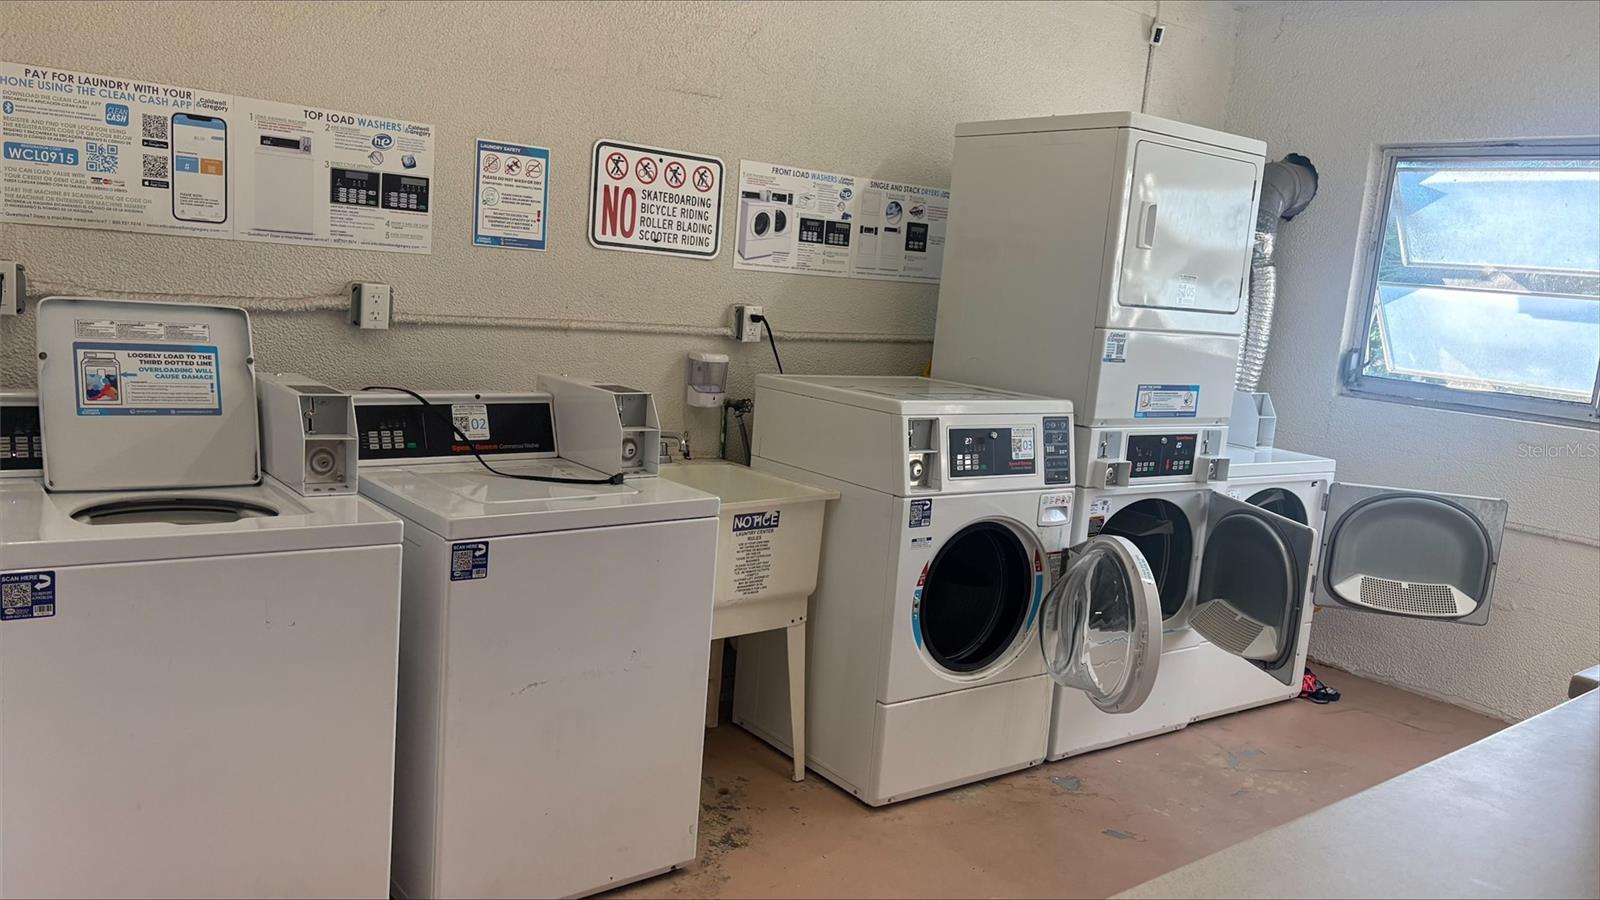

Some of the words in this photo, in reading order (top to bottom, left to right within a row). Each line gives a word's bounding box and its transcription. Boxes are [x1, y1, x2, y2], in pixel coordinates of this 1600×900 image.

[25, 68, 48, 80] PAY
[52, 72, 74, 84] FOR
[78, 76, 130, 91] LAUNDRY
[134, 84, 159, 95] WITH
[162, 88, 192, 100] YOUR
[2, 90, 40, 99] DOWNLOAD
[38, 80, 74, 94] USING
[76, 86, 96, 96] THE
[99, 88, 135, 102] CLEAN
[138, 94, 169, 106] CASH
[172, 98, 192, 110] APP
[200, 97, 226, 106] Caldwell
[107, 106, 128, 116] CLEAN
[250, 112, 253, 120] 1
[106, 113, 128, 123] CASH
[304, 110, 323, 120] TOP
[326, 113, 354, 125] LOAD
[358, 118, 402, 132] WASHERS
[78, 124, 108, 132] LOCATION
[325, 124, 330, 132] 2
[480, 143, 503, 151] LAUNDRY
[8, 147, 74, 164] WCL0915
[324, 160, 330, 168] 3
[772, 166, 792, 177] FRONT
[792, 170, 810, 179] LOAD
[810, 173, 838, 184] WASHERS
[870, 180, 889, 190] SINGLE
[904, 186, 920, 194] STACK
[920, 189, 940, 198] DRYERS
[641, 189, 712, 208] SKATEBOARDING
[601, 184, 637, 239] NO
[640, 202, 678, 218] BICYCLE
[680, 208, 709, 222] RIDING
[640, 216, 673, 230] ROLLER
[676, 220, 712, 234] BLADING
[385, 232, 390, 240] 5
[638, 230, 678, 244] SCOOTER
[681, 234, 710, 248] RIDING
[471, 418, 487, 430] 02
[1022, 440, 1032, 450] 03
[734, 514, 778, 529] NOTICE
